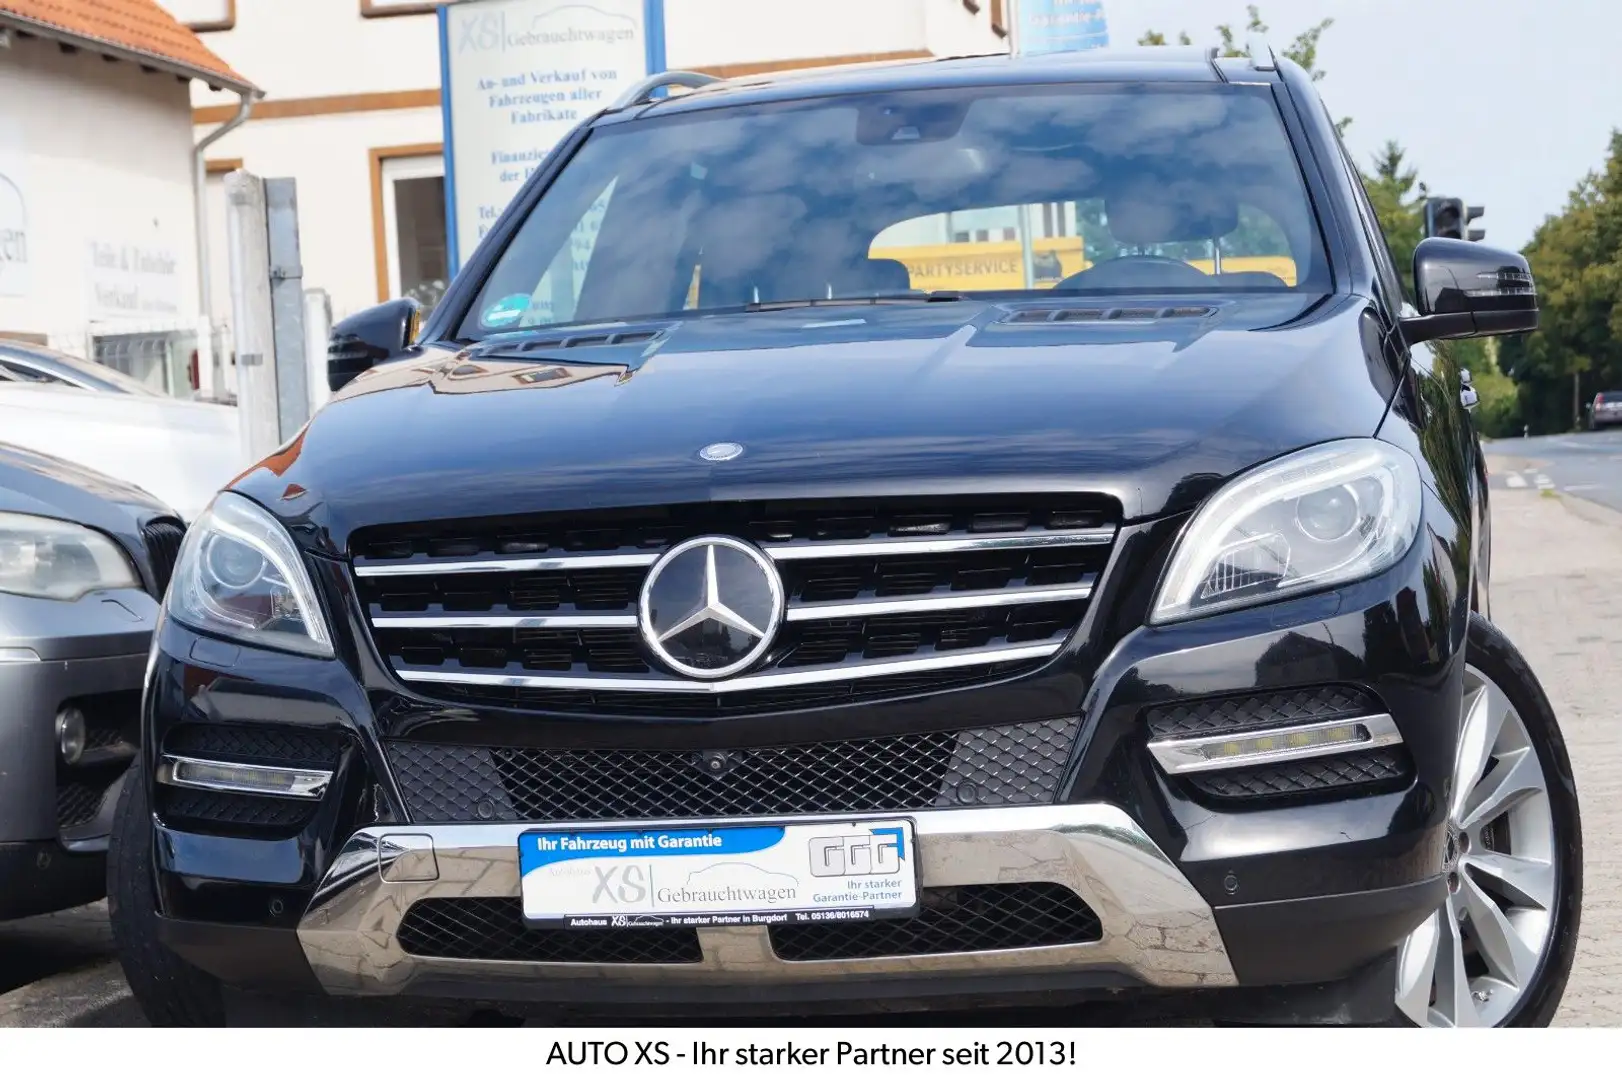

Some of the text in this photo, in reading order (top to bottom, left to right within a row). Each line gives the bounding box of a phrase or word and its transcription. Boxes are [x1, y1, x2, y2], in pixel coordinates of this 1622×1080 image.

[458, 12, 499, 53] XS
[507, 26, 635, 48] Gebrauchtwagen
[476, 68, 618, 91] An- und Verkauf von
[488, 87, 603, 108] Fahrzeugen aller
[511, 109, 578, 124] Fabrikate
[499, 169, 520, 182] der
[907, 258, 1019, 278] PARTYSERVICE
[538, 834, 722, 853] Ihr Fahrzeug mit Garantie
[592, 864, 647, 904] XS
[847, 878, 903, 889] Ihr starker
[657, 883, 797, 905] Gebrauchtwagen
[812, 891, 903, 903] Garantie-Partner
[570, 914, 627, 927] Autohaus XS
[671, 916, 682, 925] Ihr
[683, 916, 710, 925] starker
[712, 915, 742, 924] Partner
[743, 914, 750, 923] in
[752, 913, 788, 924] Burgdorf
[795, 912, 810, 921] Tel.
